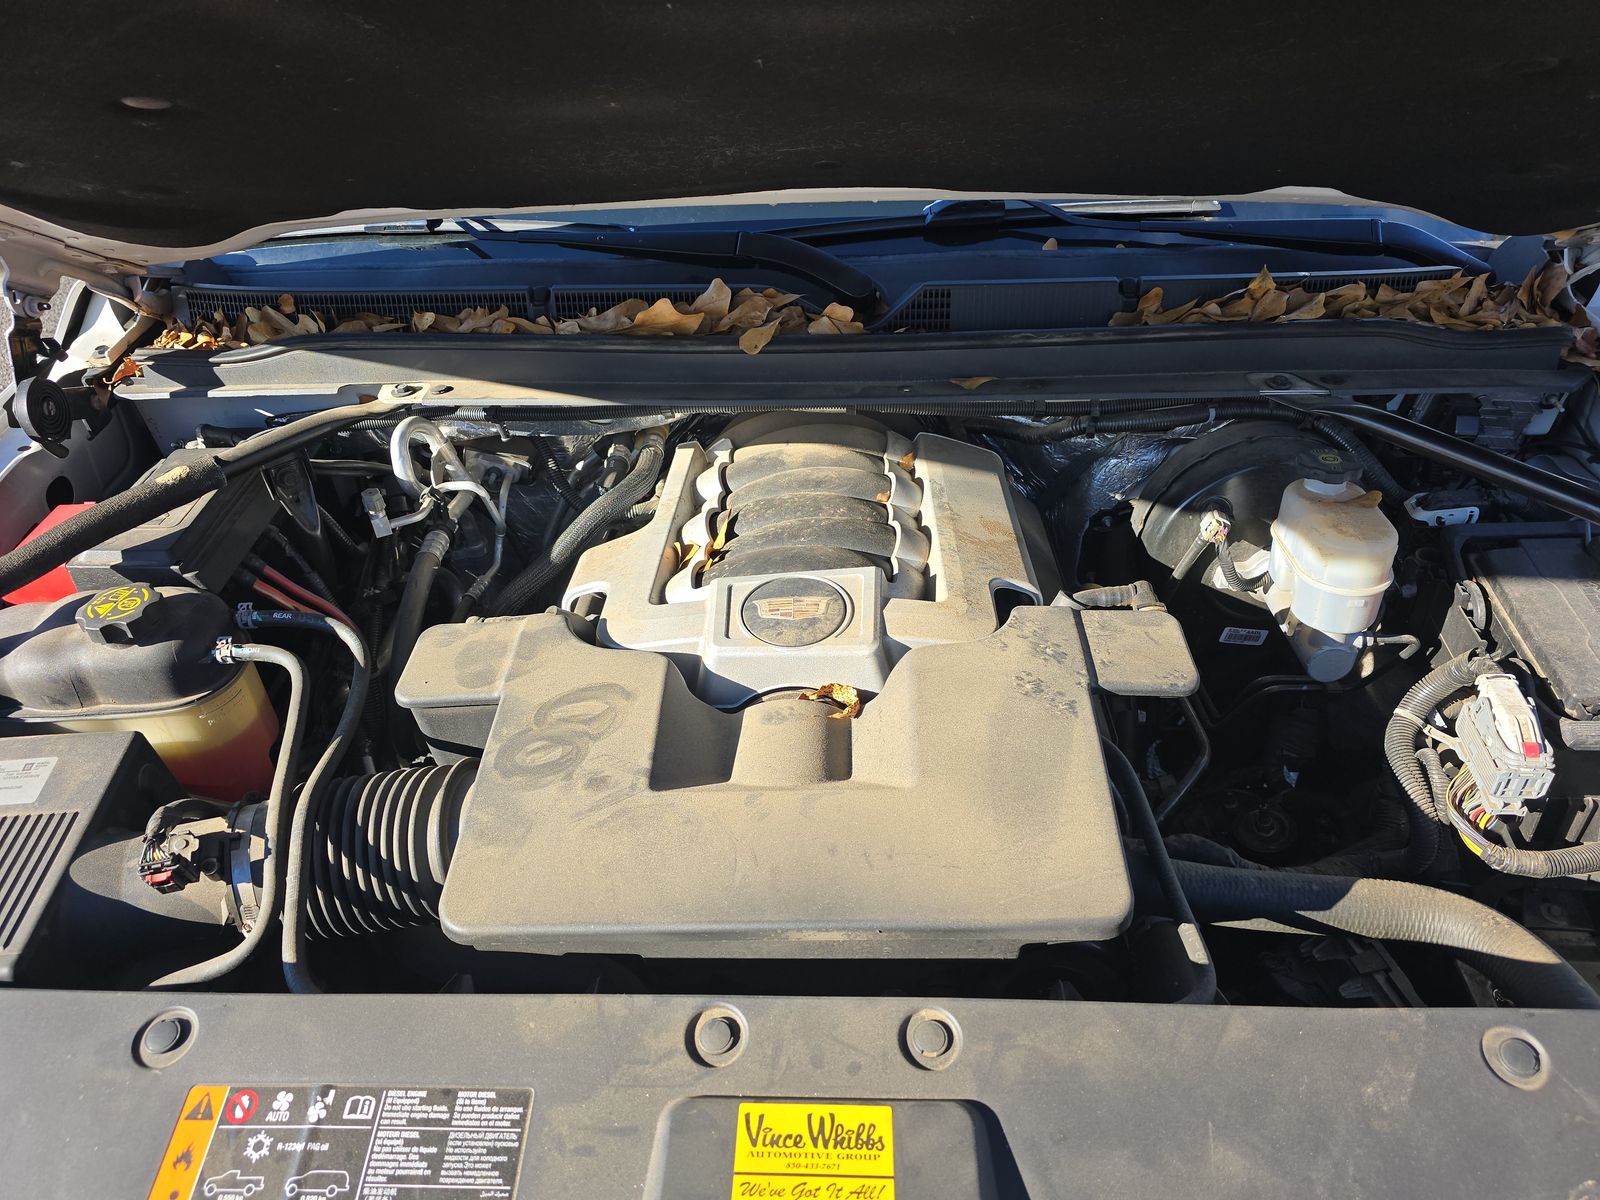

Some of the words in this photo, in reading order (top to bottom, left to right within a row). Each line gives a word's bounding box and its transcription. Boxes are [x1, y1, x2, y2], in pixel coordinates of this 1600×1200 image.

[265, 1111, 289, 1121] AUTO
[744, 1112, 806, 1149] Vince
[807, 1112, 885, 1151] Whibbs
[307, 1142, 320, 1151] PAG
[747, 1151, 832, 1160] AUTOMOTIVE
[837, 1153, 881, 1161] GROUP
[740, 1181, 786, 1197] We've
[791, 1182, 821, 1200] Got
[826, 1183, 843, 1198] It
[846, 1185, 886, 1200] All!
